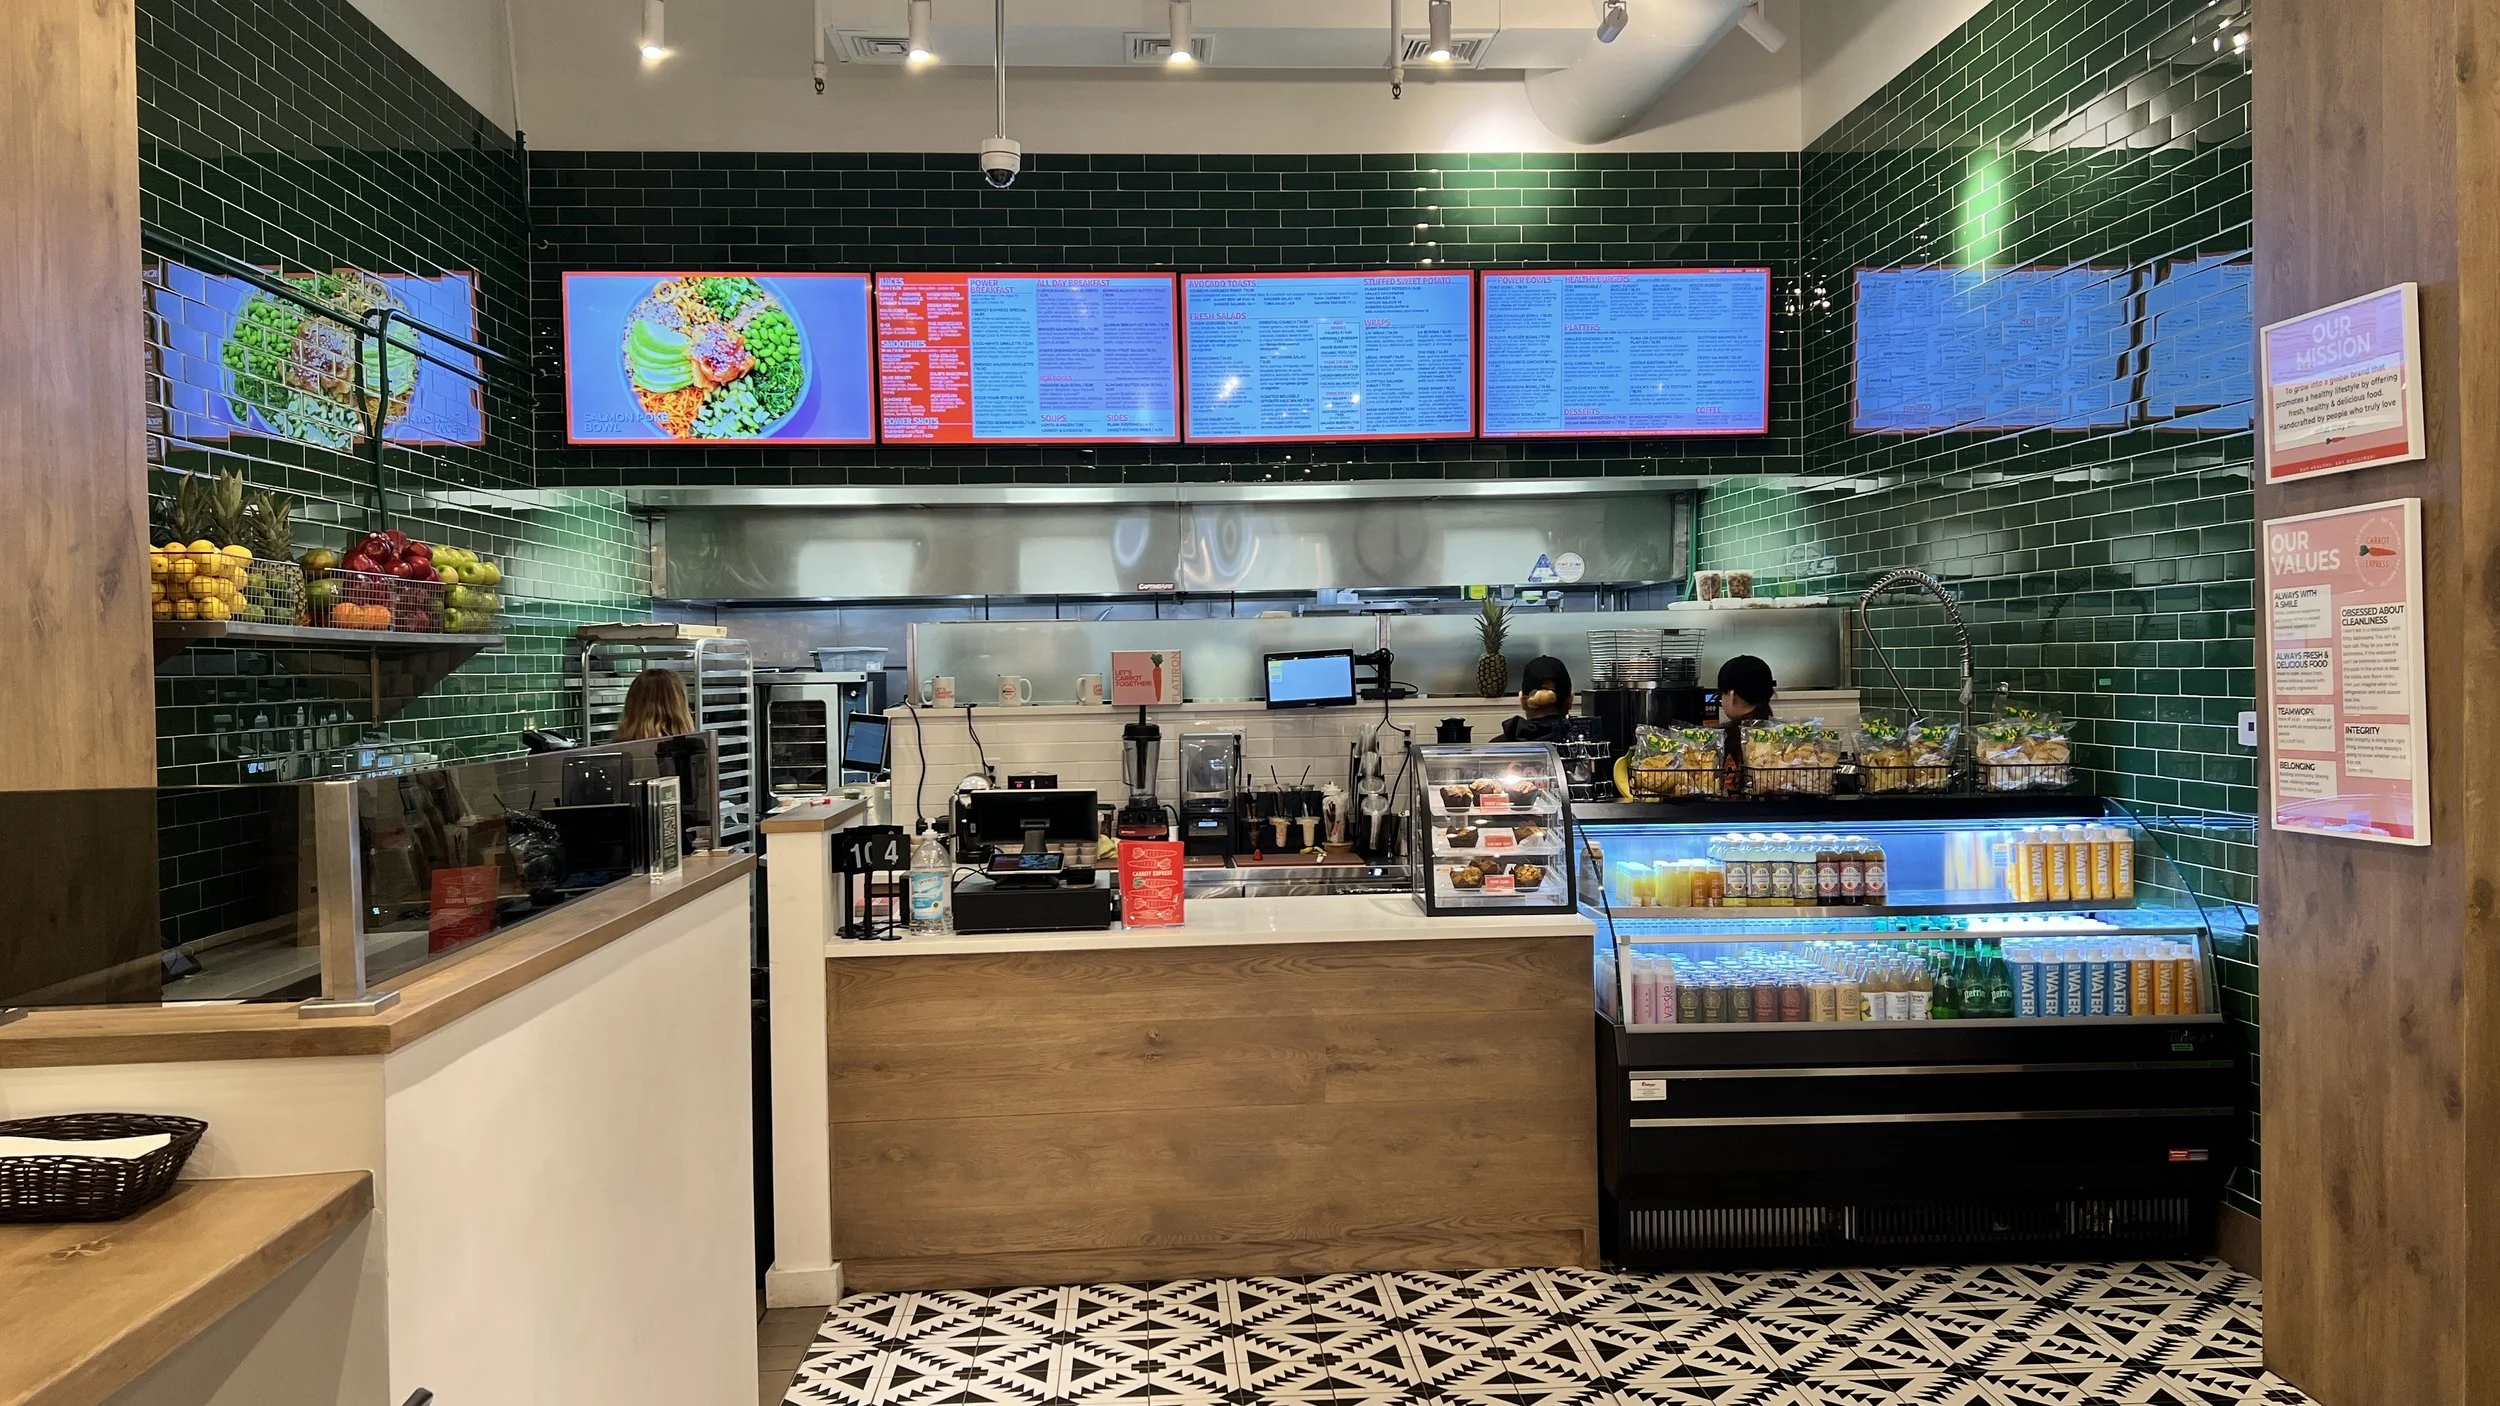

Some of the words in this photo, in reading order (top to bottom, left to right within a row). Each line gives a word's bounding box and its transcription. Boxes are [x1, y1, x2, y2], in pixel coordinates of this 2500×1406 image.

[970, 286, 1014, 294] BREAKFAST
[881, 340, 926, 348] SMOOTHIES
[2312, 315, 2352, 344] OUR
[2296, 332, 2371, 372] MISSION
[2276, 396, 2304, 410] promotes
[2310, 388, 2334, 401] healthy
[2334, 384, 2360, 395] lifestyle
[2361, 378, 2370, 389] by
[2370, 373, 2398, 386] offering
[2294, 384, 2310, 395] grow
[2310, 380, 2322, 389] into
[2330, 374, 2349, 386] global
[2350, 368, 2370, 379] brand
[2370, 364, 2386, 374] that
[583, 412, 633, 422] SALMON
[636, 412, 668, 422] POKE
[2279, 417, 2316, 431] Handcrafted
[2317, 416, 2326, 424] by
[2326, 410, 2348, 421] people
[2349, 406, 2364, 416] who
[2364, 402, 2381, 412] truly
[2382, 398, 2397, 408] love
[2288, 408, 2304, 417] fresh,
[2306, 400, 2330, 413] healthy
[2331, 400, 2336, 408] &
[2336, 393, 2366, 406] delicious
[2366, 388, 2384, 400] food.
[584, 424, 621, 433] BOWL
[2272, 530, 2309, 554] OUR
[2367, 536, 2390, 544] CARROT
[2271, 548, 2341, 576] VALUES
[2366, 559, 2390, 568] EXPRESS
[2274, 590, 2300, 600] ALWAYS
[2300, 589, 2317, 598] WITH
[2280, 600, 2298, 608] SMILE
[2342, 607, 2378, 617] OBSESSED
[2378, 605, 2404, 615] ABOUT
[2342, 616, 2388, 626] CLEANLINESS
[2276, 652, 2302, 660] ALWAYS
[2302, 651, 2323, 660] FRESH
[2324, 651, 2328, 659] &
[2276, 660, 2308, 669] DELICIOUS
[2310, 660, 2328, 668] FOOD
[1172, 652, 1180, 702] FLATIRON
[2278, 708, 2315, 716] TEAMWORK
[2345, 726, 2380, 734] INTEGRITY
[2280, 762, 2316, 771] BELONGING
[884, 840, 899, 864] 4
[2098, 849, 2108, 884] WATER
[2120, 848, 2130, 884] WATER
[2031, 850, 2042, 886] WATER
[2054, 850, 2064, 886] WATER
[2076, 850, 2087, 885] WATER
[2021, 970, 2035, 1015] WATER
[2046, 970, 2058, 1015] WATER
[2068, 968, 2080, 1014] WATER
[2090, 968, 2104, 1014] WATER
[2113, 968, 2126, 1013] WATER
[2138, 968, 2148, 1005] WATER
[2160, 968, 2170, 1006] WATER
[2183, 967, 2192, 1004] WATER
